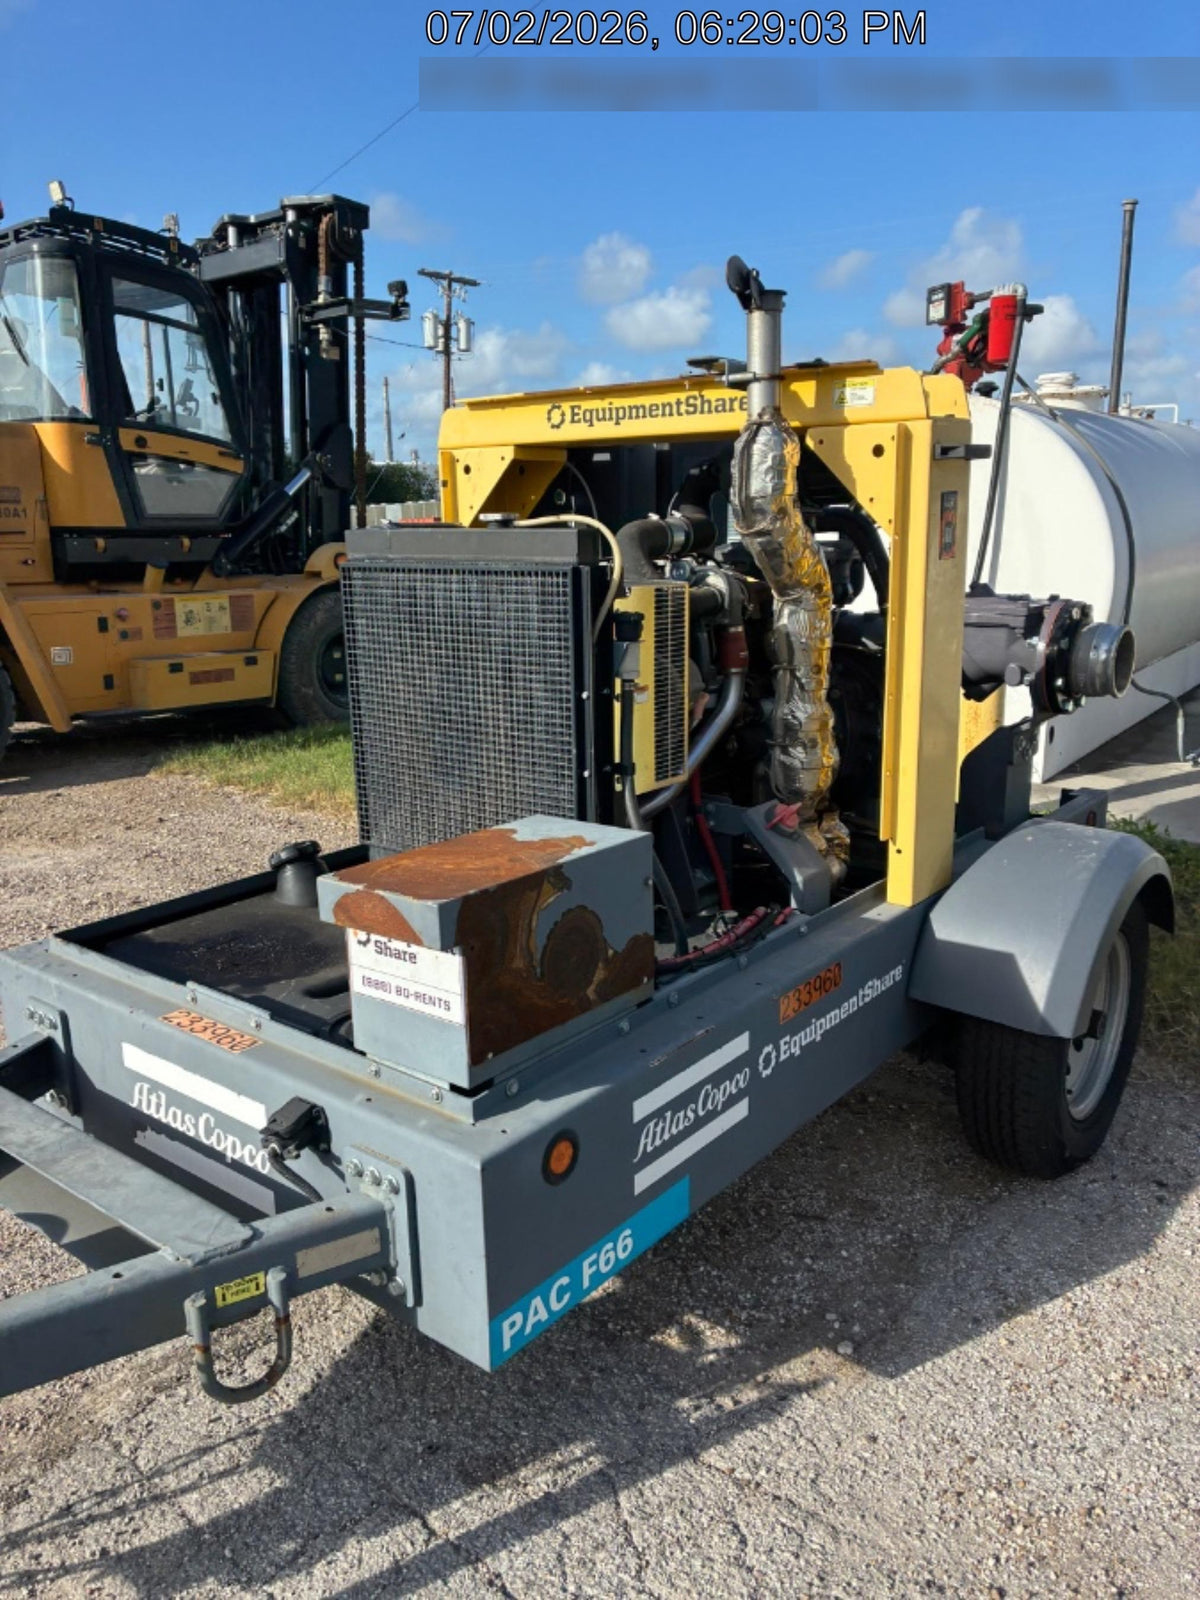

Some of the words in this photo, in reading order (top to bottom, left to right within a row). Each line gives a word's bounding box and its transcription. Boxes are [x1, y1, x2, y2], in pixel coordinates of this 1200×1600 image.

[569, 393, 748, 427] EquipmentShare
[374, 940, 418, 964] Share
[782, 961, 843, 1020] 233960
[779, 964, 903, 1063] EquipmentShare
[129, 1081, 197, 1138] Atlas
[198, 1112, 271, 1175] Copco
[633, 1103, 697, 1163] Atlas
[697, 1067, 751, 1118] Copco
[502, 1275, 571, 1353] PAC
[582, 1227, 634, 1291] F66
